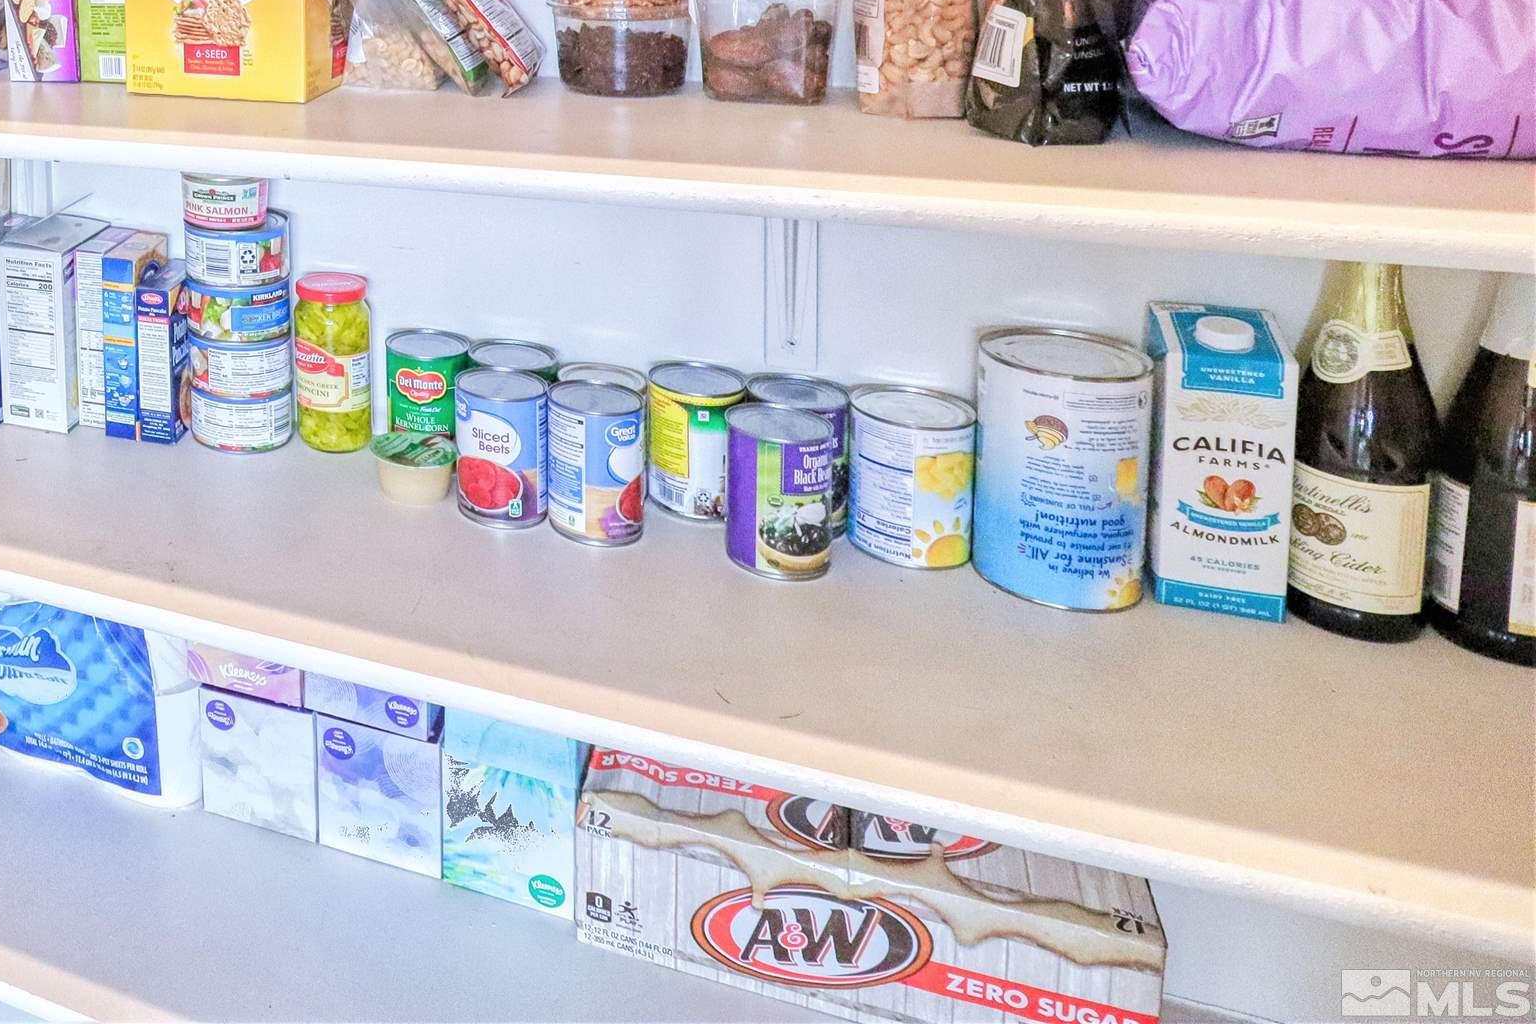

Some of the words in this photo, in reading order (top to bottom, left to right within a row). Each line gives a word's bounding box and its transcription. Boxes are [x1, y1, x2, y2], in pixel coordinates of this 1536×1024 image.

[195, 49, 228, 60] 6-SEED
[1064, 82, 1081, 93] NET
[1083, 82, 1100, 92] WT
[206, 207, 249, 216] SALMON
[5, 258, 33, 267] Nutrition
[34, 261, 53, 269] Facts
[38, 283, 54, 291] 200
[252, 289, 283, 302] KIRKLAND
[399, 375, 413, 388] Del
[413, 378, 444, 391] Monte
[1208, 374, 1256, 386] VANILLA
[394, 416, 424, 431] KERNEL
[424, 422, 450, 432] CORN
[405, 412, 437, 425] WHOLE
[471, 426, 511, 444] Sliced
[611, 425, 637, 439] Great
[478, 441, 512, 455] Beets
[1172, 436, 1287, 465] CALIFIA
[1197, 456, 1262, 471] FARMS
[793, 469, 817, 485] Black
[1018, 518, 1041, 532] with
[1034, 509, 1097, 529] nutrition!
[1101, 513, 1126, 531] good
[875, 519, 912, 535] Calories
[1043, 525, 1099, 539] everywhere
[1169, 520, 1281, 547] ALMONDMILK
[1019, 529, 1054, 545] provide
[873, 543, 912, 560] Nutrition
[1056, 540, 1066, 550] to
[1069, 541, 1106, 553] promise
[1053, 552, 1073, 568] for
[1077, 553, 1128, 568] Sunshine
[1207, 557, 1261, 571] CALORIES
[1329, 549, 1386, 575] Cider
[1048, 563, 1059, 575] in
[1061, 566, 1095, 580] believe
[1097, 568, 1111, 579] We
[218, 663, 269, 687] Kleenex
[601, 752, 678, 784] SUGAR
[685, 771, 754, 794] ZERO
[587, 809, 614, 831] 12
[586, 825, 612, 839] PACK
[594, 894, 604, 908] 0
[1116, 914, 1145, 937] 12
[620, 933, 638, 946] CANS
[739, 906, 880, 969] A&W
[616, 941, 634, 955] CANS
[945, 972, 1030, 1009] ZERO
